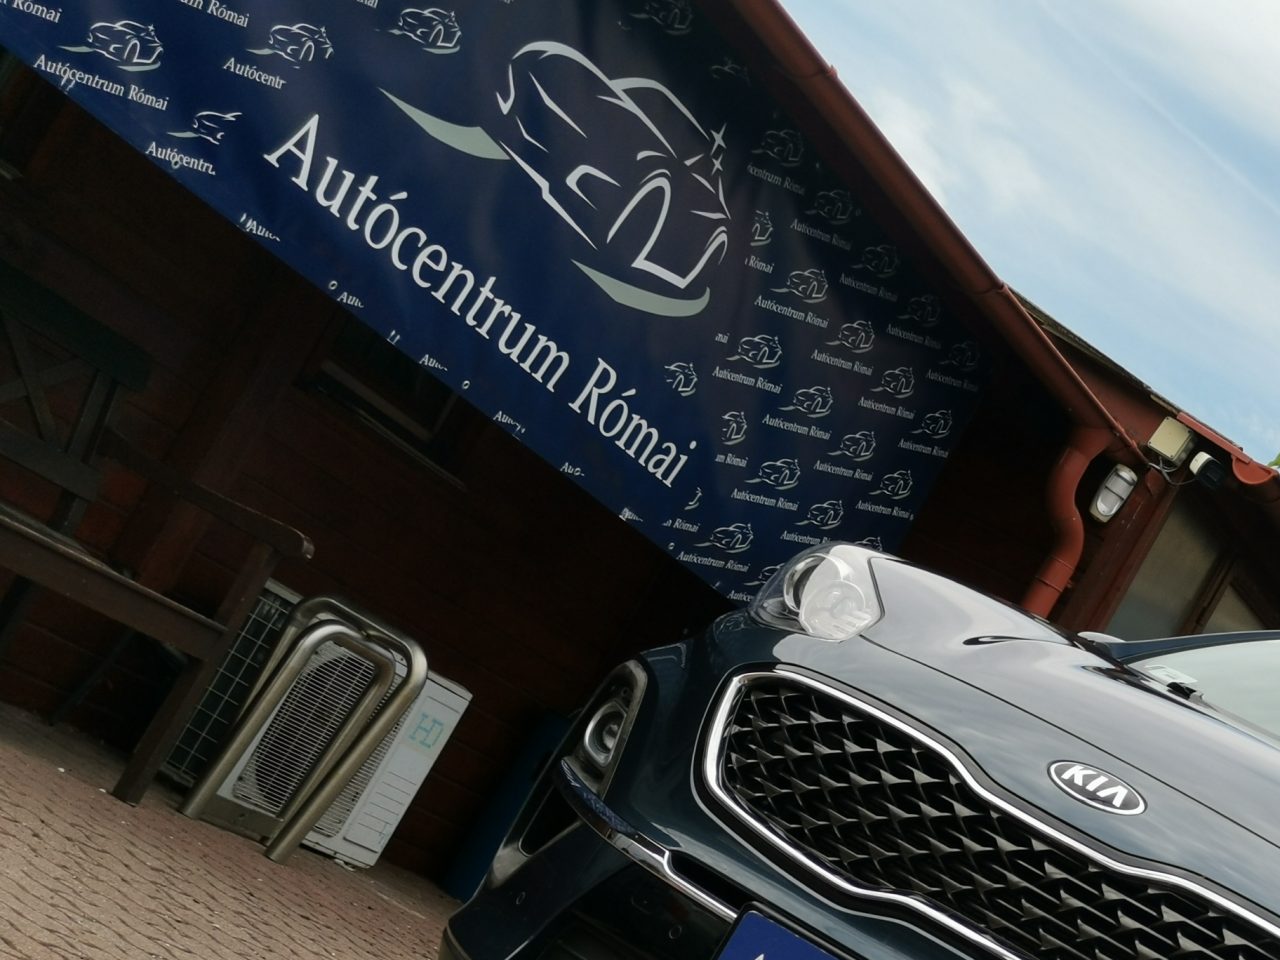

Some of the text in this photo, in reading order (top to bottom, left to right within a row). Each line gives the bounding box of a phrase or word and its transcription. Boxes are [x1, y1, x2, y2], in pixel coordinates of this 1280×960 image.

[33, 54, 170, 111] Autócentrum Római
[263, 113, 698, 488] Autócentrum Római
[754, 295, 830, 329] Autócentrum Római
[811, 349, 874, 376] Autócentrum Római
[712, 366, 783, 395] Autócentrum Római
[762, 414, 832, 441] Autócentrum Római
[726, 453, 749, 468] Római
[731, 488, 800, 512] Autócentrum Római
[676, 551, 751, 573] Autócentrum Római
[1061, 763, 1129, 808] KIA
